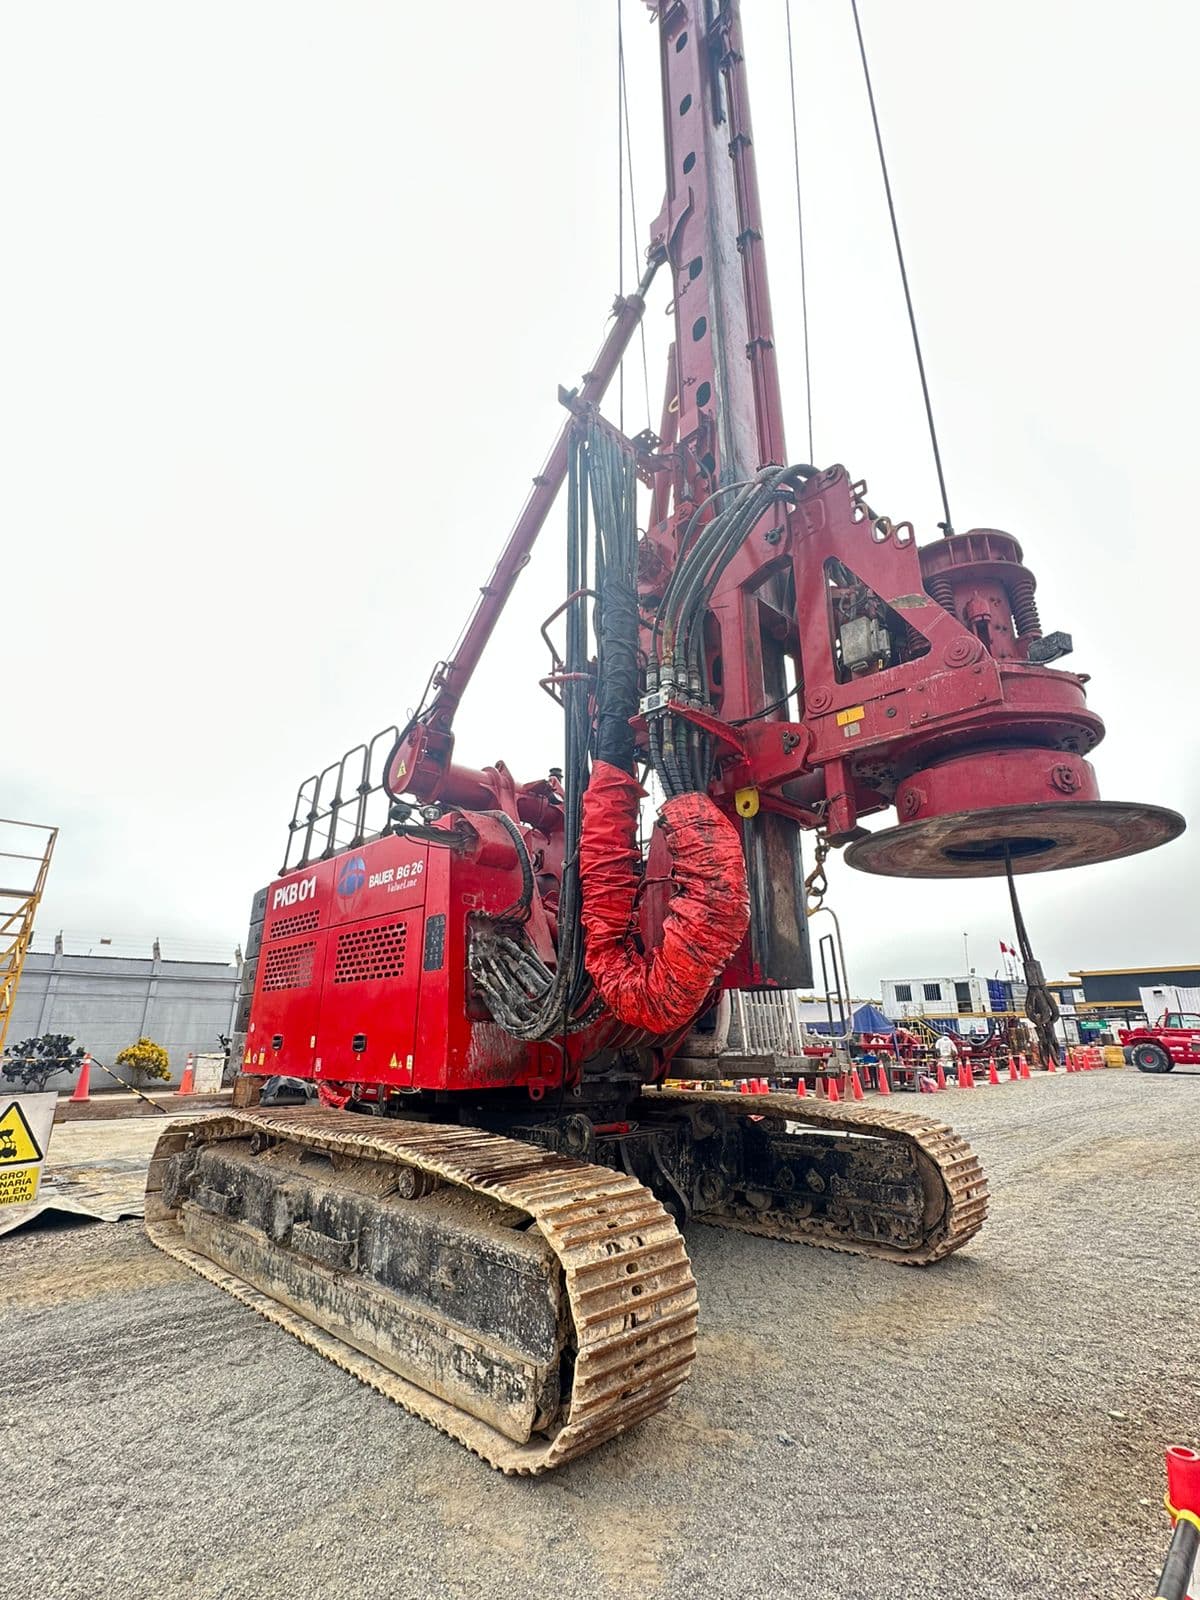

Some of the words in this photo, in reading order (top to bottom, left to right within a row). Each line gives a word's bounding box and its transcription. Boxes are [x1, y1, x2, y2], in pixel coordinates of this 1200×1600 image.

[369, 868, 394, 888] BAUER
[396, 864, 411, 880] BG
[411, 860, 424, 876] 26
[273, 876, 316, 910] PKB01
[13, 1186, 27, 1194] EN
